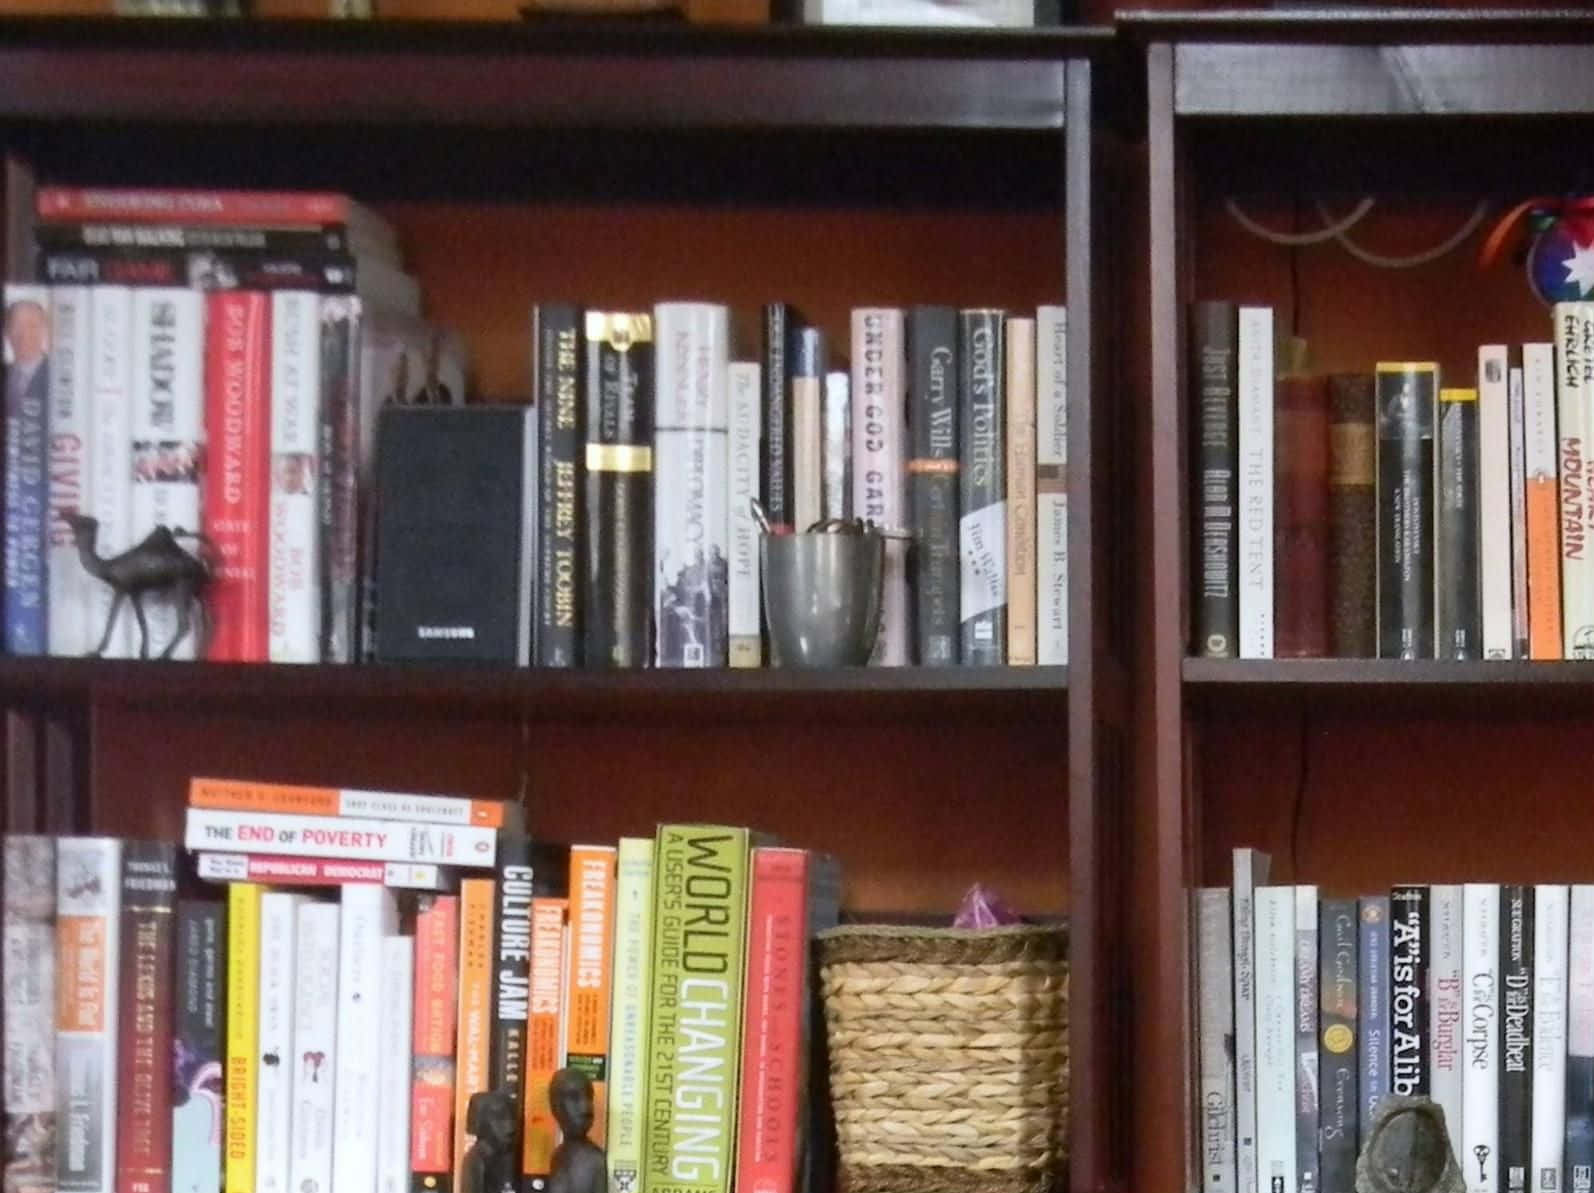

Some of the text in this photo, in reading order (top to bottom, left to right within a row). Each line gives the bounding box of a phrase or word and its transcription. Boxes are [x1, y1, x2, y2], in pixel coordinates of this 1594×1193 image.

[558, 327, 577, 429] THE NINE
[923, 346, 952, 458] Garry Wills
[1563, 315, 1580, 389] EHRLICH
[971, 327, 997, 487] God's Politics
[552, 460, 576, 627] JEFFREY TOOBIN
[1562, 437, 1585, 561] MOUNTAIN
[419, 627, 475, 639] SAMSUNG
[204, 825, 388, 849] THE END OF POVERTY
[498, 865, 534, 1020] CULTURE JAM
[576, 859, 607, 989] FREAKONOMICS
[1393, 957, 1419, 983] is
[650, 832, 685, 1177] A USER'S GUIDE FOR THE 21ST CENTURY
[1393, 984, 1421, 1028] for
[1466, 1003, 1494, 1070] Corpse
[1504, 1003, 1529, 1072] Deadbeat
[230, 1056, 248, 1161] BRIGHT-SIDED
